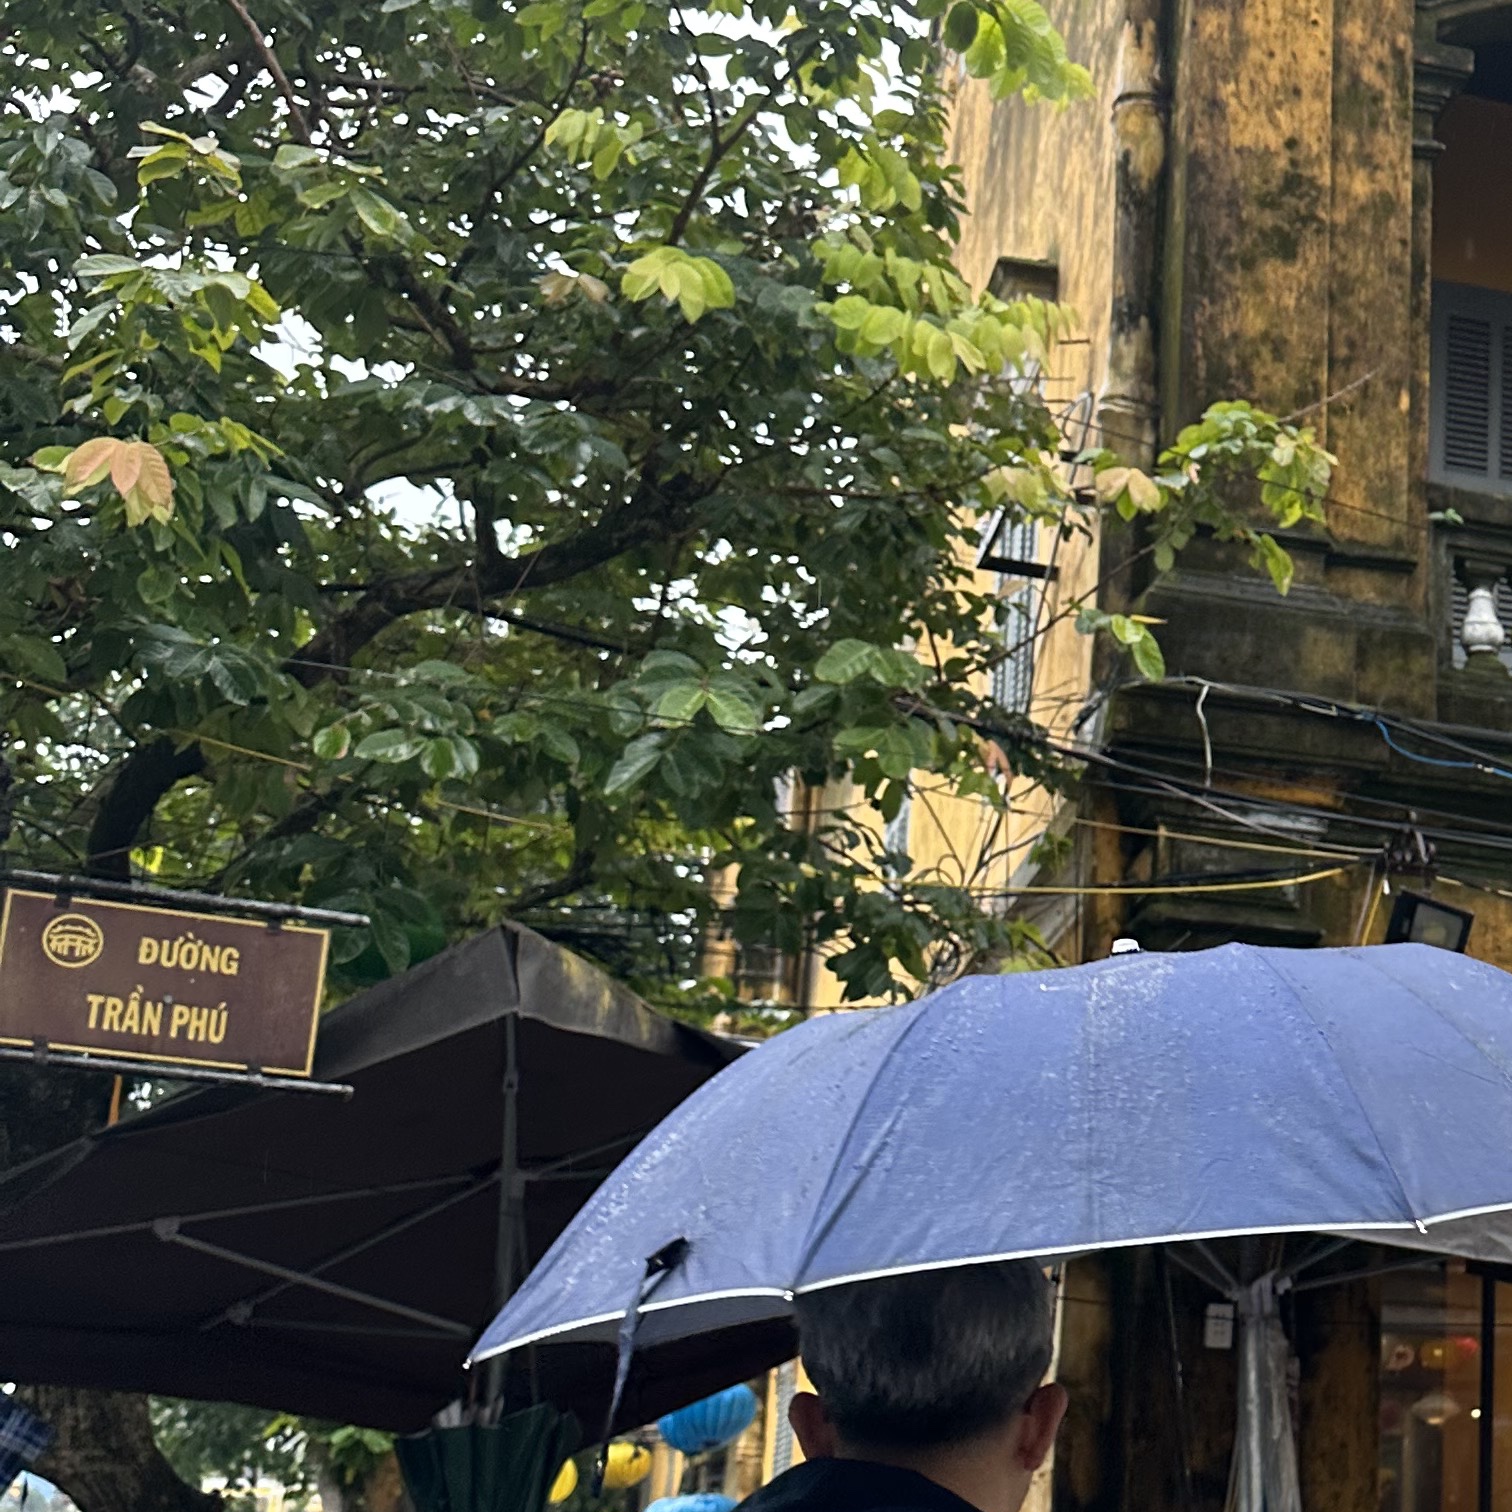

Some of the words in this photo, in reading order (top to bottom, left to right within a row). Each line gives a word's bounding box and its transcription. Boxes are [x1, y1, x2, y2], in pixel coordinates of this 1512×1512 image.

[137, 932, 241, 976] ĐƯỜNG
[86, 984, 164, 1037] TRẦN
[169, 1001, 229, 1044] PHÚ
